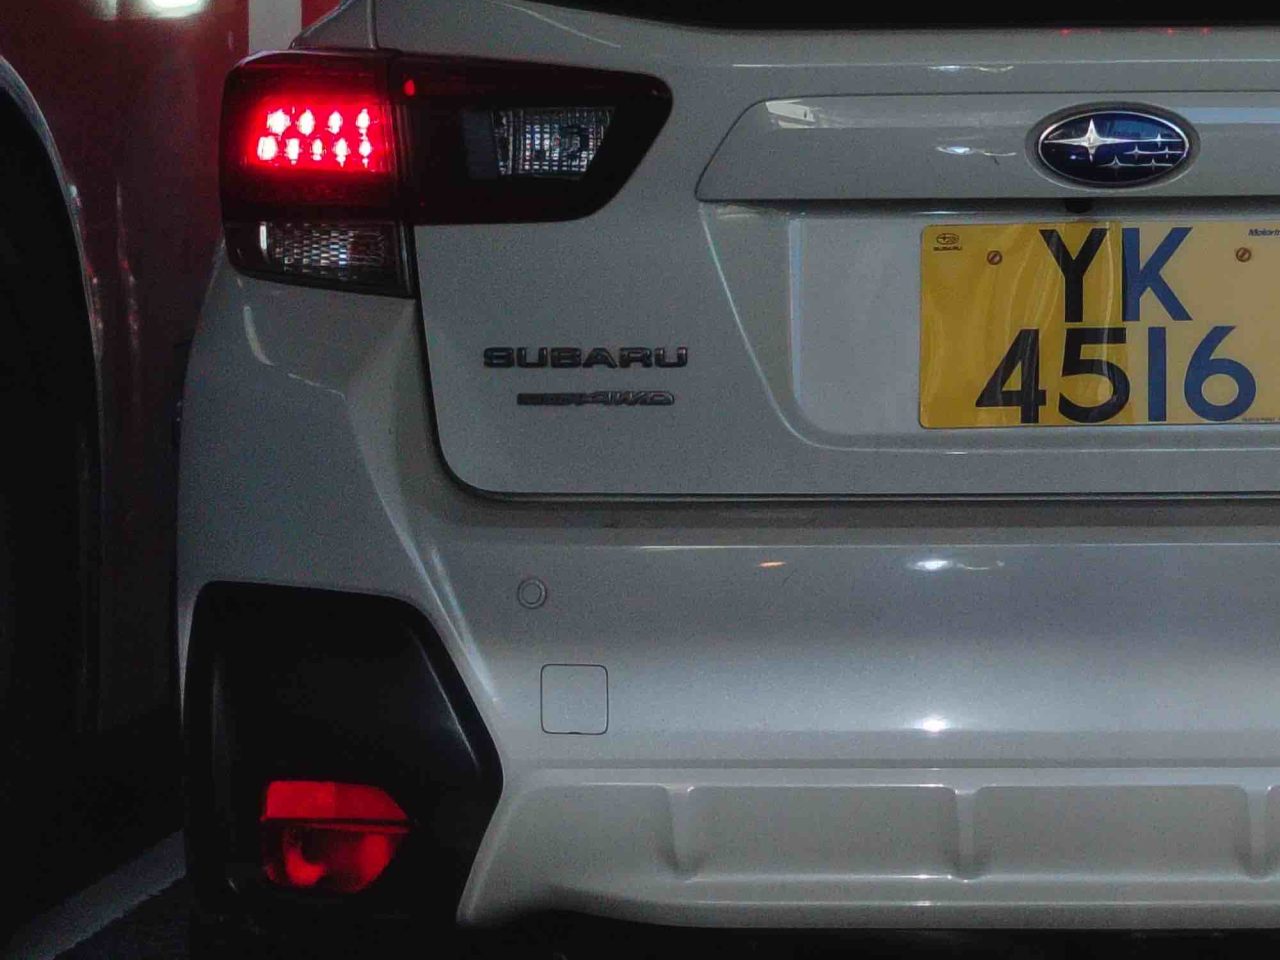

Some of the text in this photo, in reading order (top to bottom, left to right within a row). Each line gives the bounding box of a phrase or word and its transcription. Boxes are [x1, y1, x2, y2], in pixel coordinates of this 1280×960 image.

[1039, 226, 1194, 323] YK
[483, 346, 688, 369] SUBARU
[974, 325, 1257, 424] 4516
